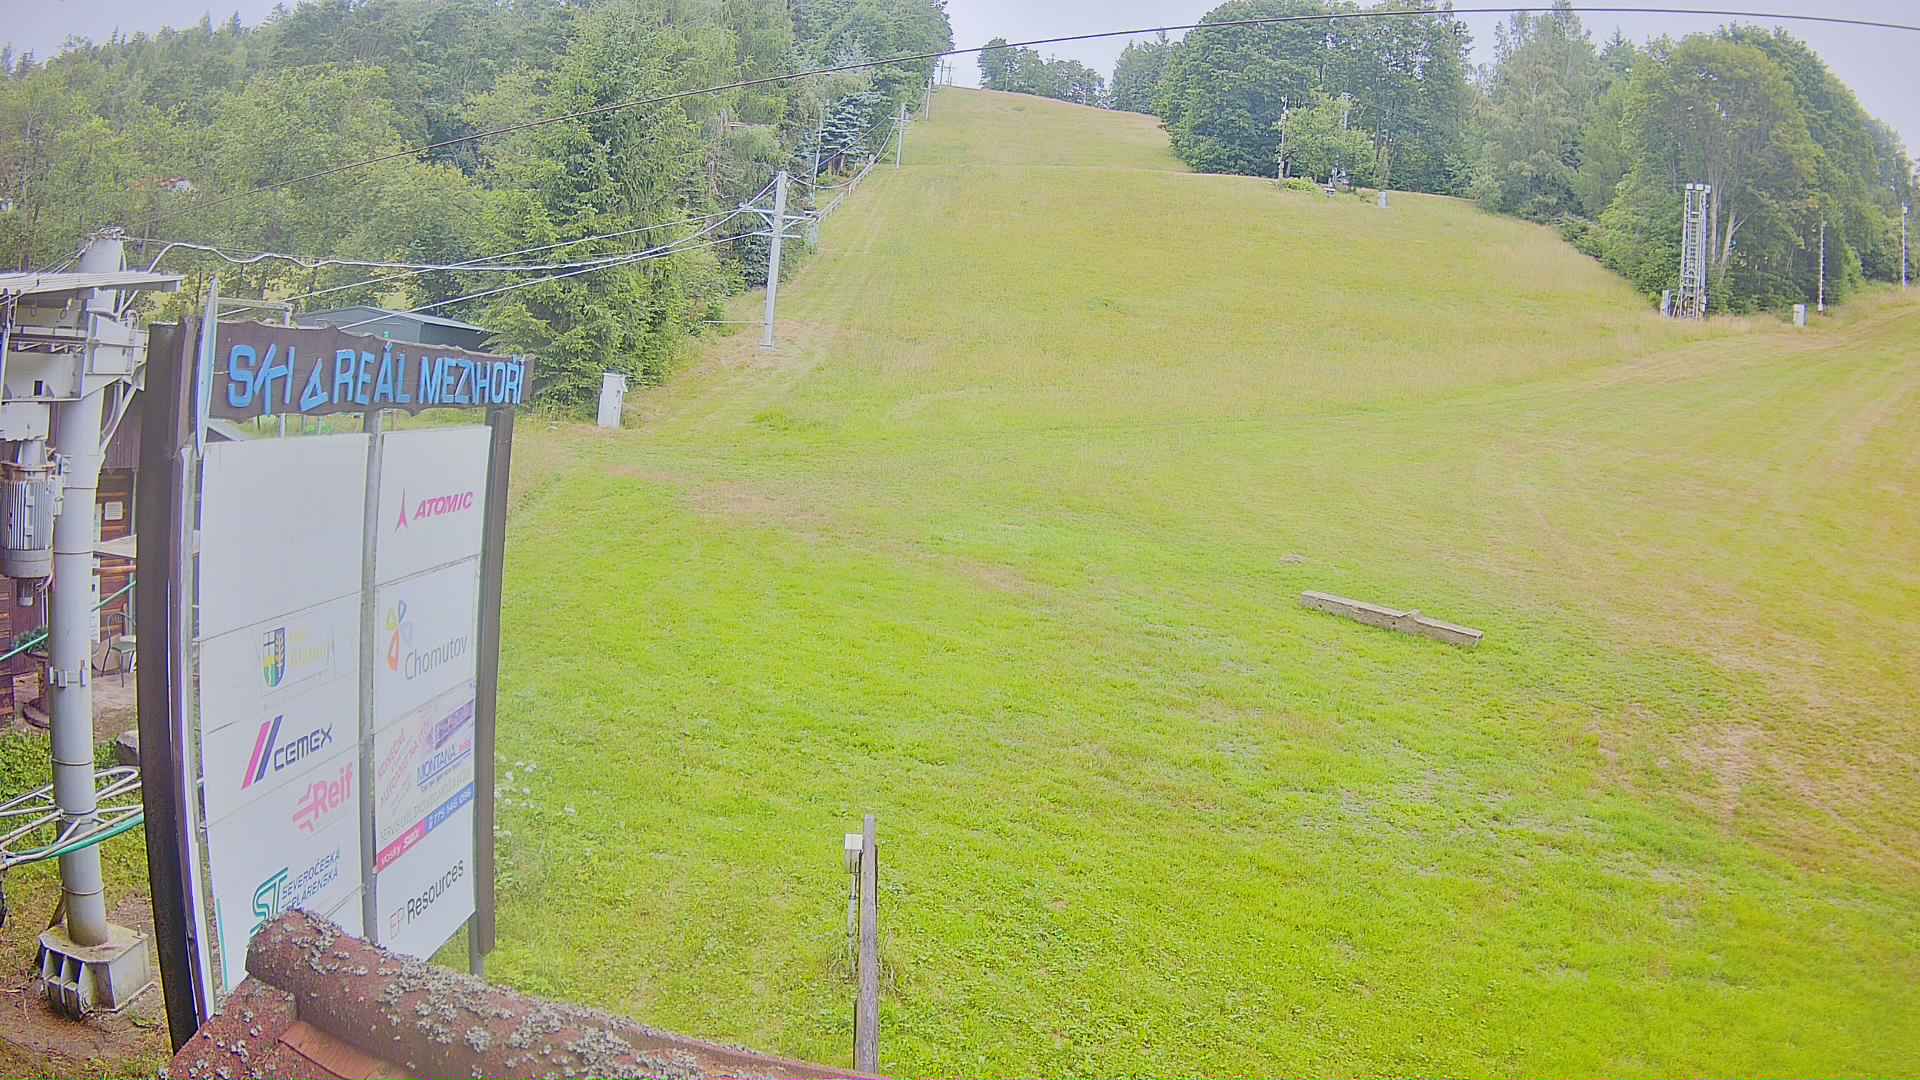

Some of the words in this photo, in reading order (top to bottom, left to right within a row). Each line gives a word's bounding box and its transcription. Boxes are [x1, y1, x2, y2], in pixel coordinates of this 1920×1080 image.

[413, 491, 474, 521] ATOMIC
[404, 634, 468, 681] Chomutov
[273, 723, 333, 772] CEMEX
[313, 761, 353, 820] Reif
[406, 859, 464, 924] Resources
